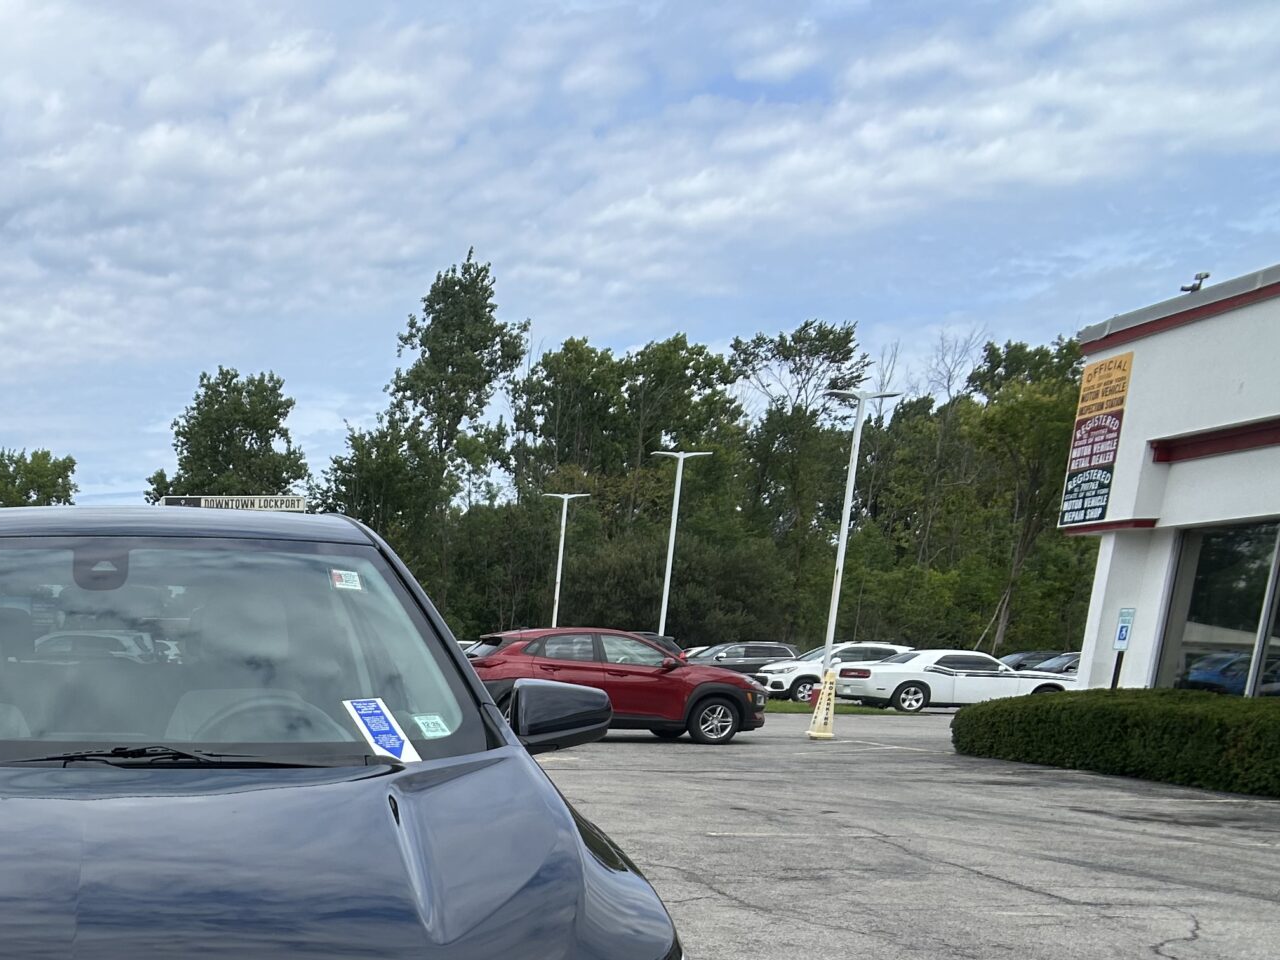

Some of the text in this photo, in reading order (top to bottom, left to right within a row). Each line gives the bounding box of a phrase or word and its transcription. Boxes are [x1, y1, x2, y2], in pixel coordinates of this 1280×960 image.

[1086, 360, 1127, 383] OFFICIAL
[1101, 382, 1127, 397] VEHICLE
[1076, 414, 1120, 440] REGISTERED
[1093, 438, 1118, 454] VEHICLE
[1091, 451, 1115, 466] DEALER
[1067, 469, 1111, 491] REGISTERED
[204, 498, 301, 510] DOWNTOWN LOCKPORT
[1083, 495, 1108, 509] VEHICLE
[1063, 507, 1103, 522] REPAIR SHOP
